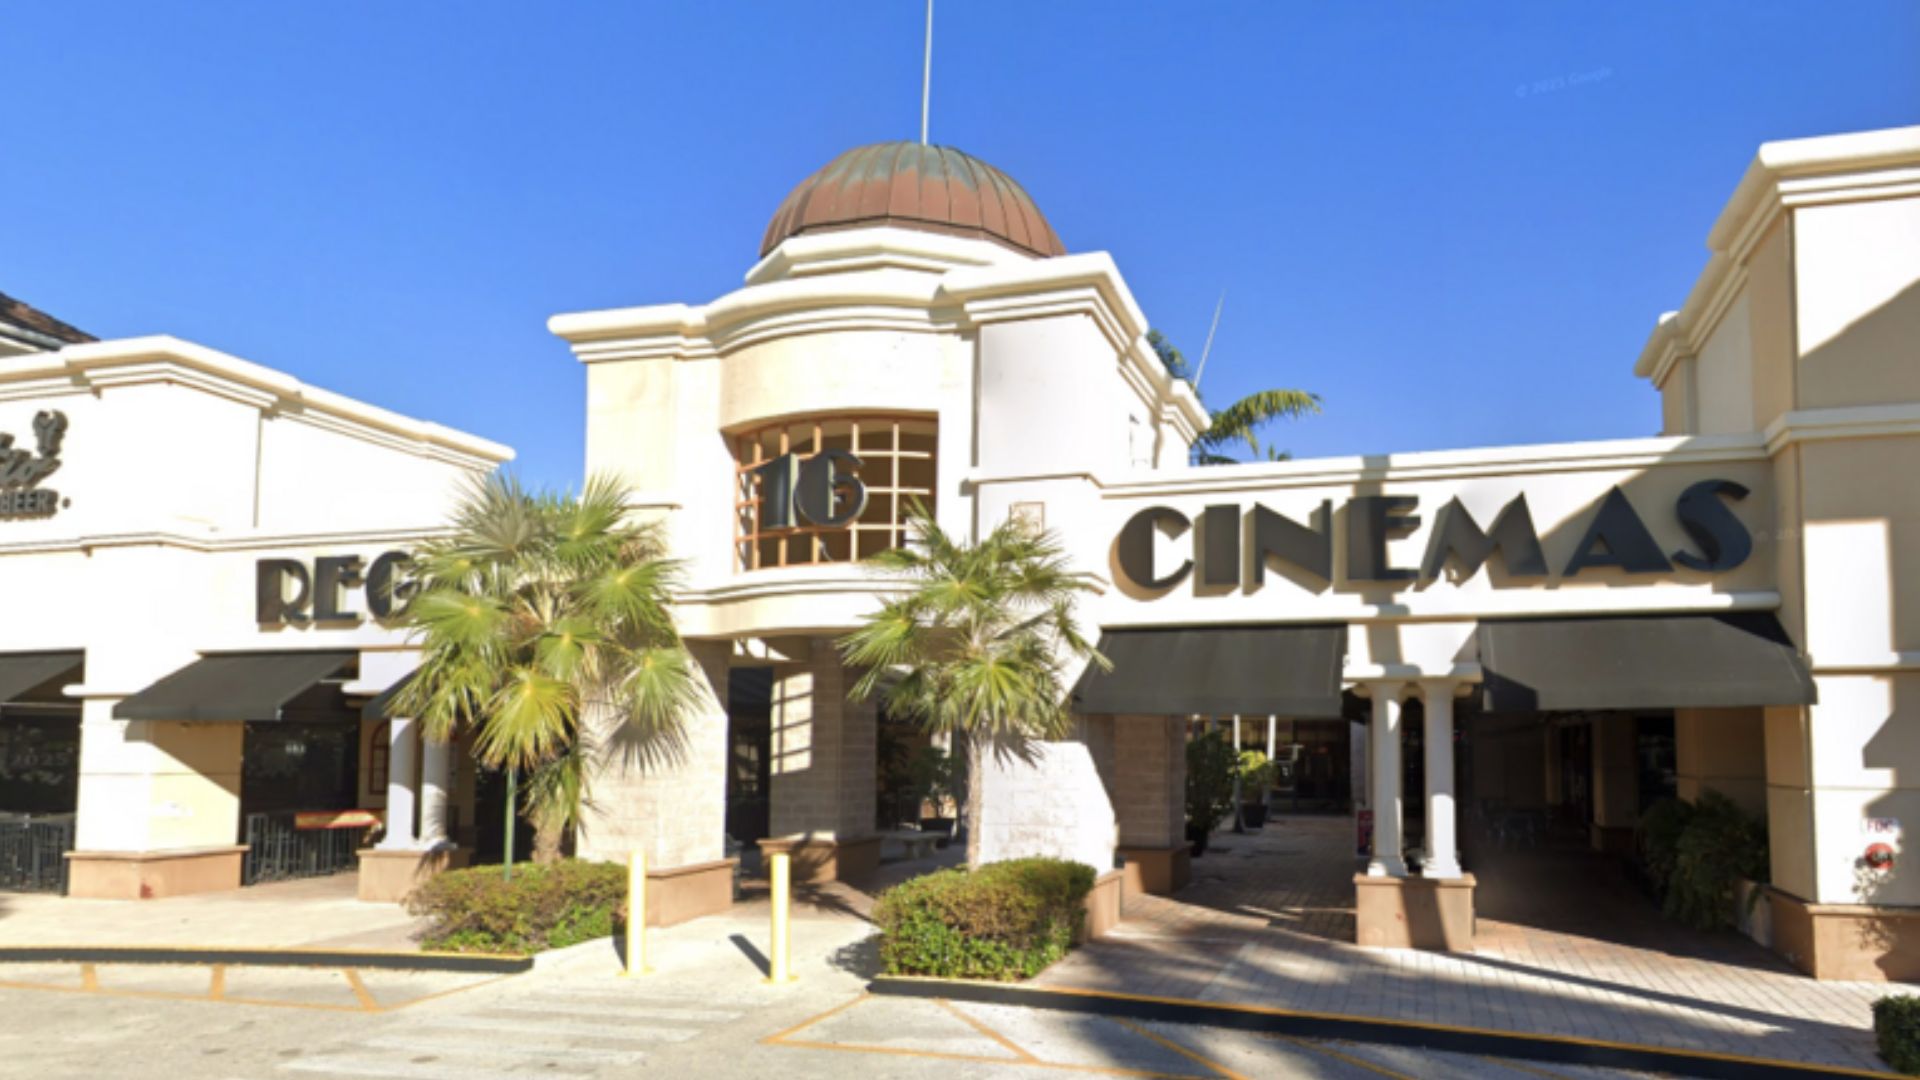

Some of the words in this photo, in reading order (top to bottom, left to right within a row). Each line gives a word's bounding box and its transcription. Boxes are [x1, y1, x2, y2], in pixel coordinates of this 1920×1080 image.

[752, 449, 867, 528] 16
[1109, 478, 1752, 601] CINEMAS
[256, 550, 422, 632] REG
